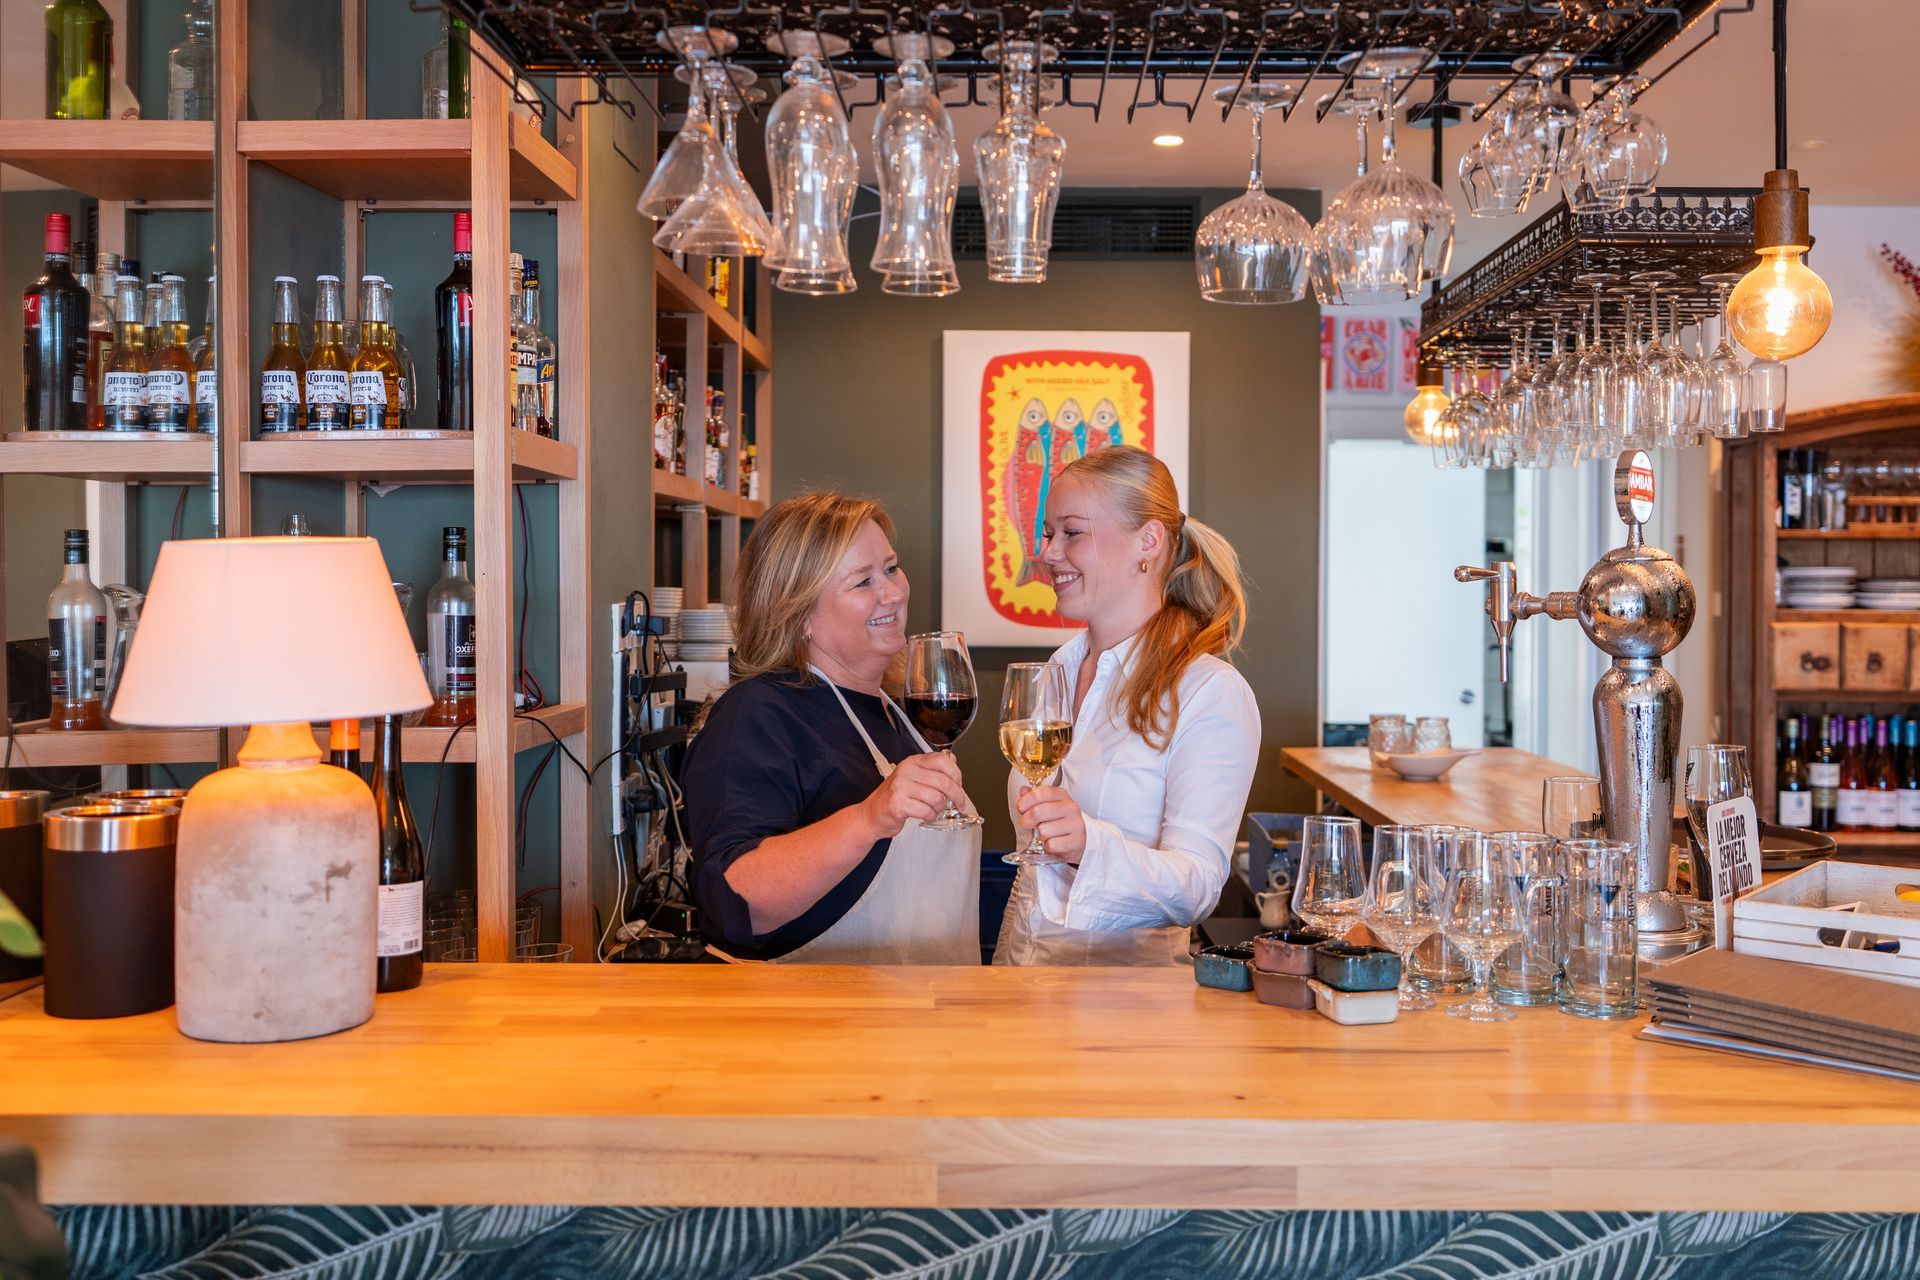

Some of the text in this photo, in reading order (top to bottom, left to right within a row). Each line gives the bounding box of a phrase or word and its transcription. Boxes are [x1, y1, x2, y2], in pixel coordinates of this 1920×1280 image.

[306, 371, 346, 386] Corona
[312, 383, 339, 391] cerveza
[352, 373, 381, 386] orona
[1715, 814, 1747, 845] LA MEJOR
[1719, 839, 1748, 870] CERVEZA
[1718, 869, 1730, 897] DEL
